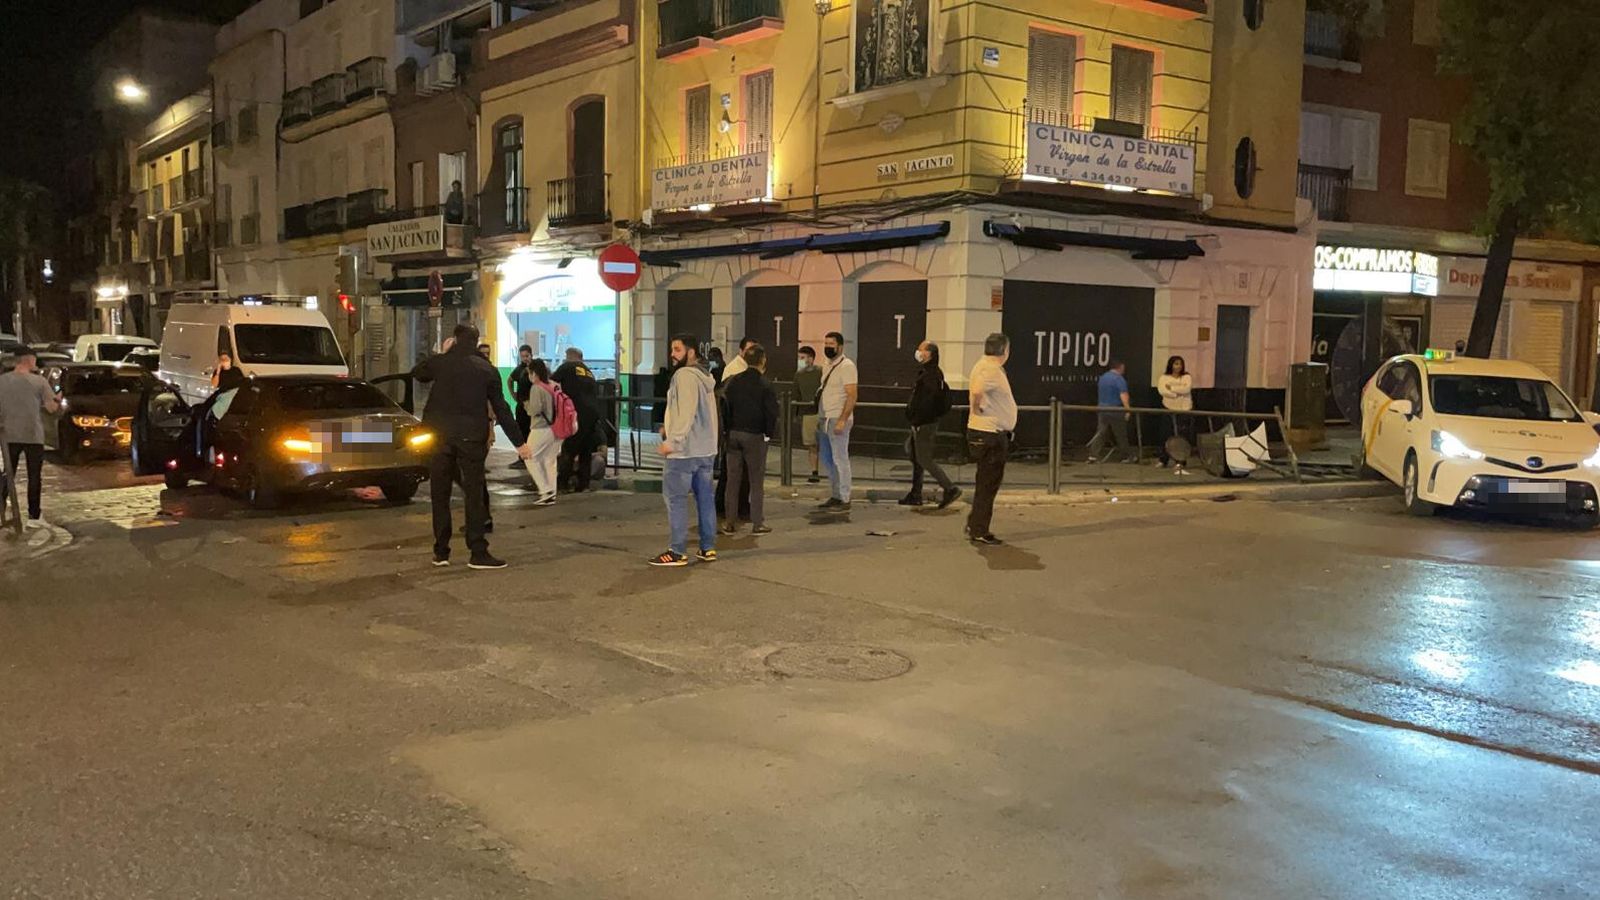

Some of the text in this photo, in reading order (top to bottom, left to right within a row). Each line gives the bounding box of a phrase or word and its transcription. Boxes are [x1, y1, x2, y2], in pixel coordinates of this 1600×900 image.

[1036, 126, 1189, 160] CLINICA DENTAL
[1049, 143, 1177, 175] Virgen de la Estrella
[656, 156, 762, 182] CLINICA DENTAL
[877, 156, 953, 176] SAN JACINTO
[773, 316, 783, 347] T
[894, 314, 905, 349] T
[1034, 331, 1110, 367] TIPICO
